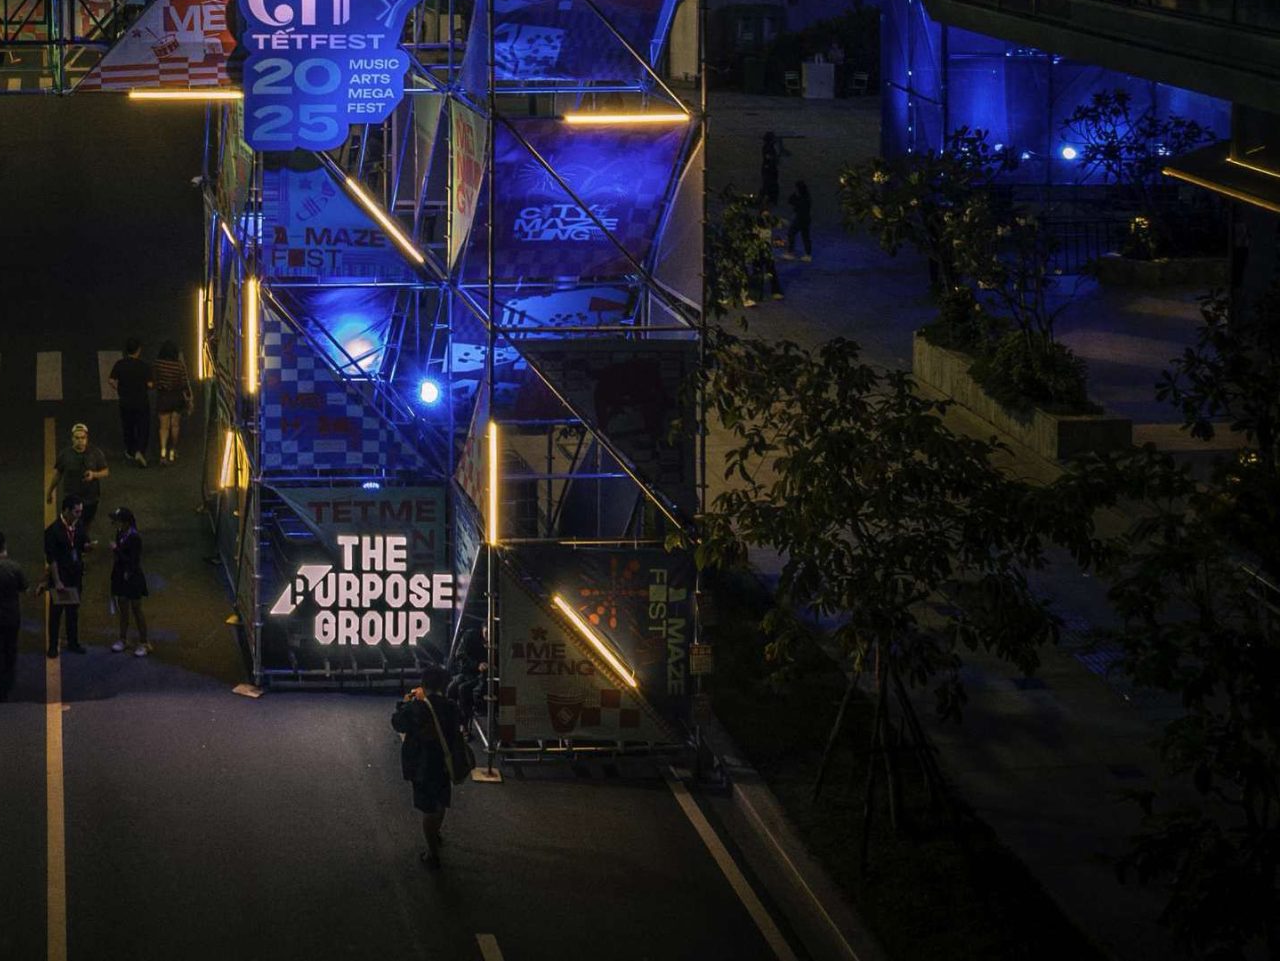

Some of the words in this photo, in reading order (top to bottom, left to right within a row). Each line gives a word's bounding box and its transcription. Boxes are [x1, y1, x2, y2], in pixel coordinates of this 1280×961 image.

[252, 57, 342, 96] 20
[349, 58, 400, 70] MUSIC
[349, 73, 391, 85] ARTS
[347, 102, 386, 113] FEST
[348, 88, 395, 100] MEGA
[252, 104, 340, 142] 25
[337, 535, 407, 571] THE
[270, 564, 453, 615] PURPOSE
[314, 609, 431, 646] GROUP
